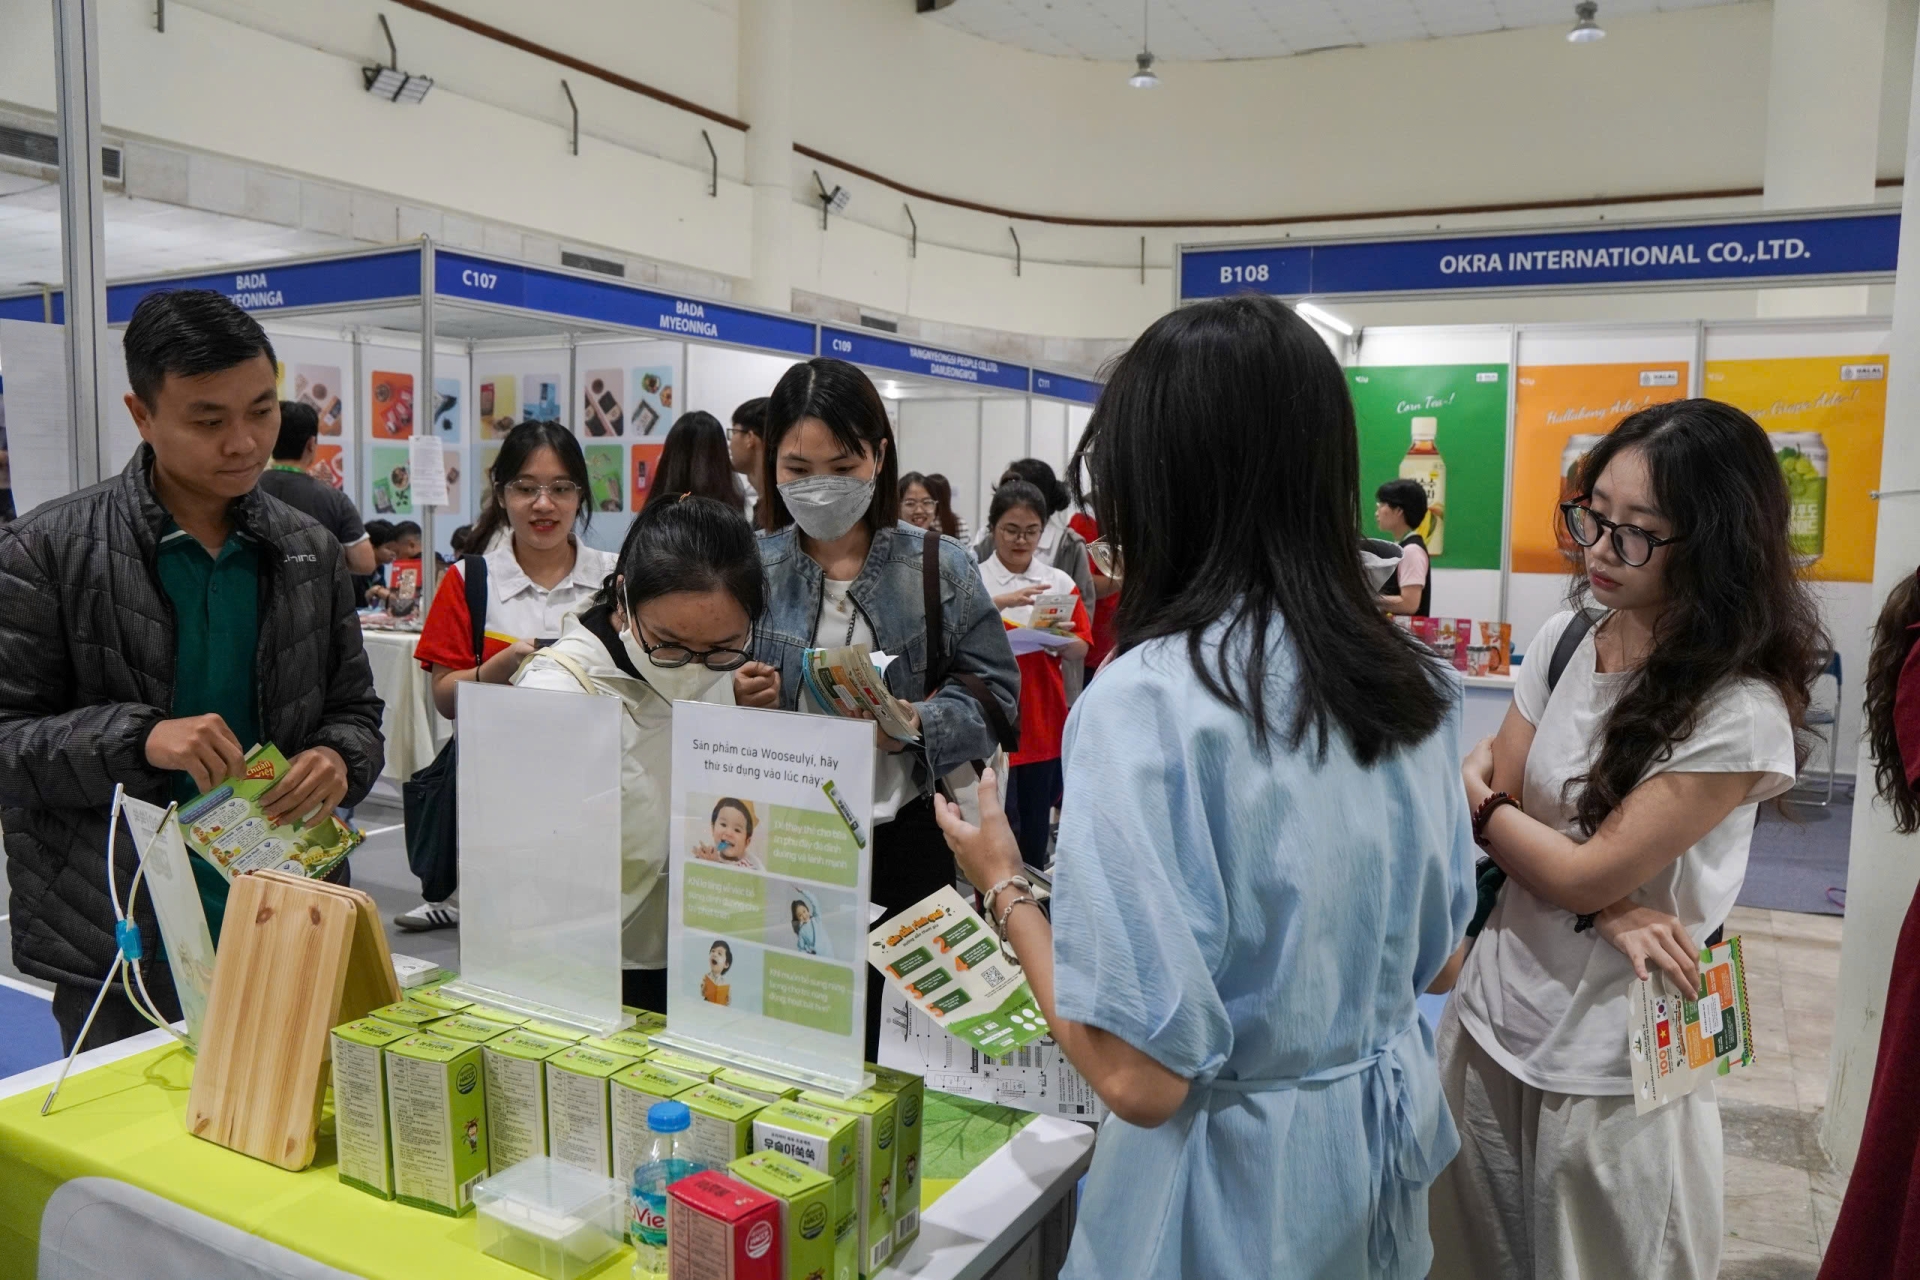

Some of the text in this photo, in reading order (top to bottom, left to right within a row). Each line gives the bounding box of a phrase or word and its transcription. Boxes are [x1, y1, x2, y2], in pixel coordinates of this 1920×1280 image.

[1439, 238, 1811, 274] OKRA INTERNATIONAL CO.,LTD.
[236, 273, 267, 290] BADA
[462, 269, 497, 289] C107
[1220, 264, 1269, 284] B108
[676, 301, 704, 318] BADA
[660, 315, 718, 337] MYEONNGA
[833, 339, 852, 353] C109
[957, 355, 979, 369] PEOPLE
[1397, 401, 1422, 414] Corn
[692, 738, 839, 771] Sản phẩm của Wooseulyi, hãy
[704, 758, 720, 771] thử
[722, 762, 734, 773] sử
[736, 762, 760, 780] dụng
[763, 768, 781, 781] vào
[784, 769, 799, 783] lúc
[932, 935, 951, 955] 2
[885, 963, 902, 980] 1
[954, 955, 970, 972] 4
[904, 983, 923, 1000] 3
[925, 1002, 945, 1018] 5
[1658, 1050, 1669, 1077] 100
[459, 1071, 476, 1083] HACCP
[803, 1212, 824, 1227] HACCP
[749, 1230, 770, 1245] HACCP
